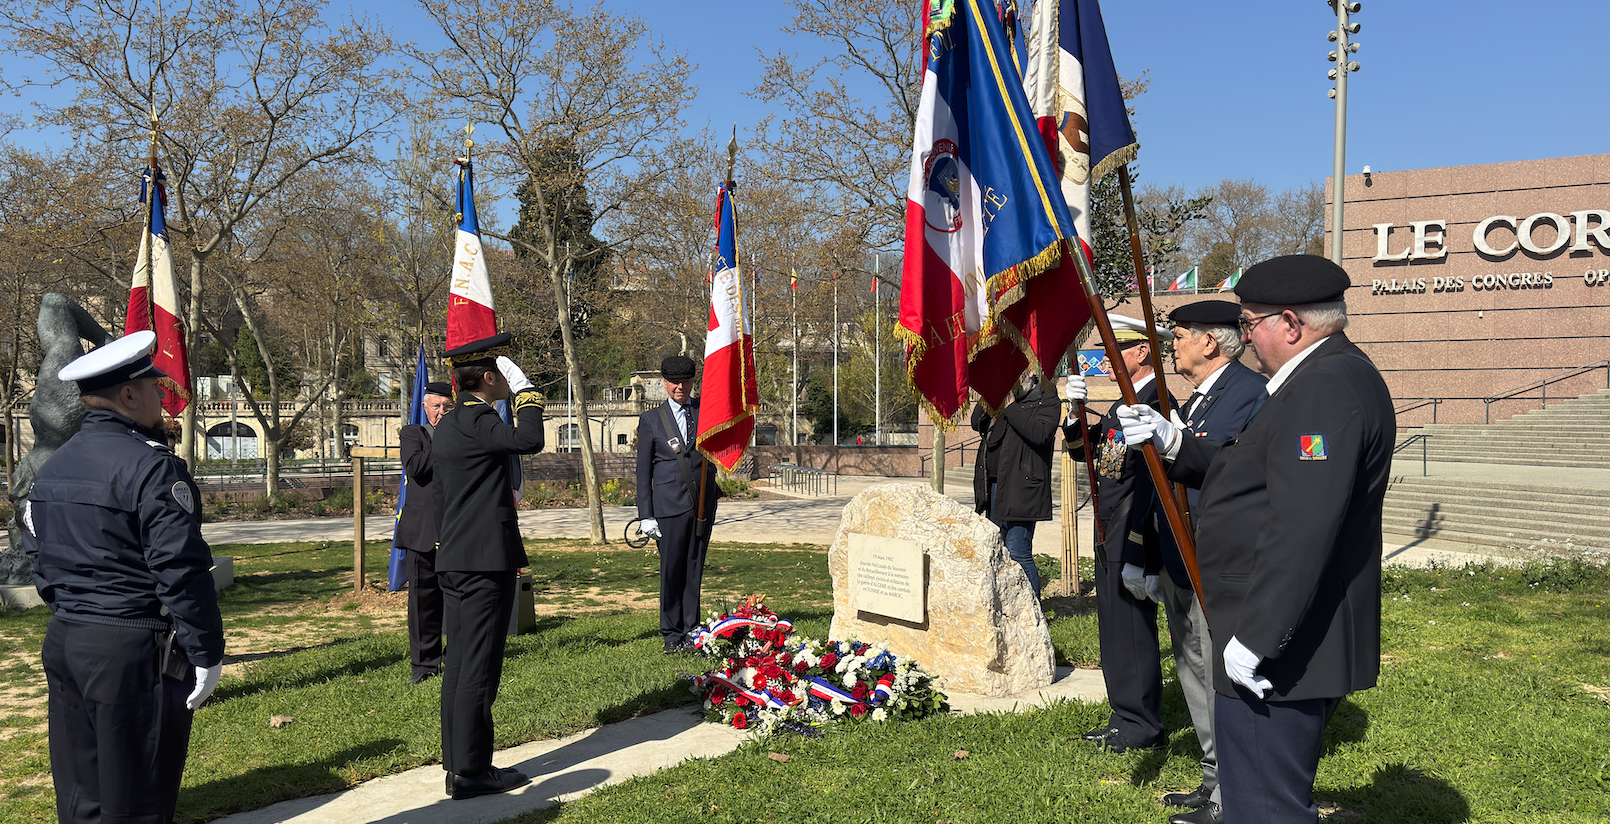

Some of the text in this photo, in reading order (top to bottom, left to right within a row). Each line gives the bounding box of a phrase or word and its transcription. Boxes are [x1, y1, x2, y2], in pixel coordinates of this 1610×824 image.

[1372, 209, 1610, 262] LE COR
[1372, 268, 1609, 292] PALAIS DES CONGRES OP
